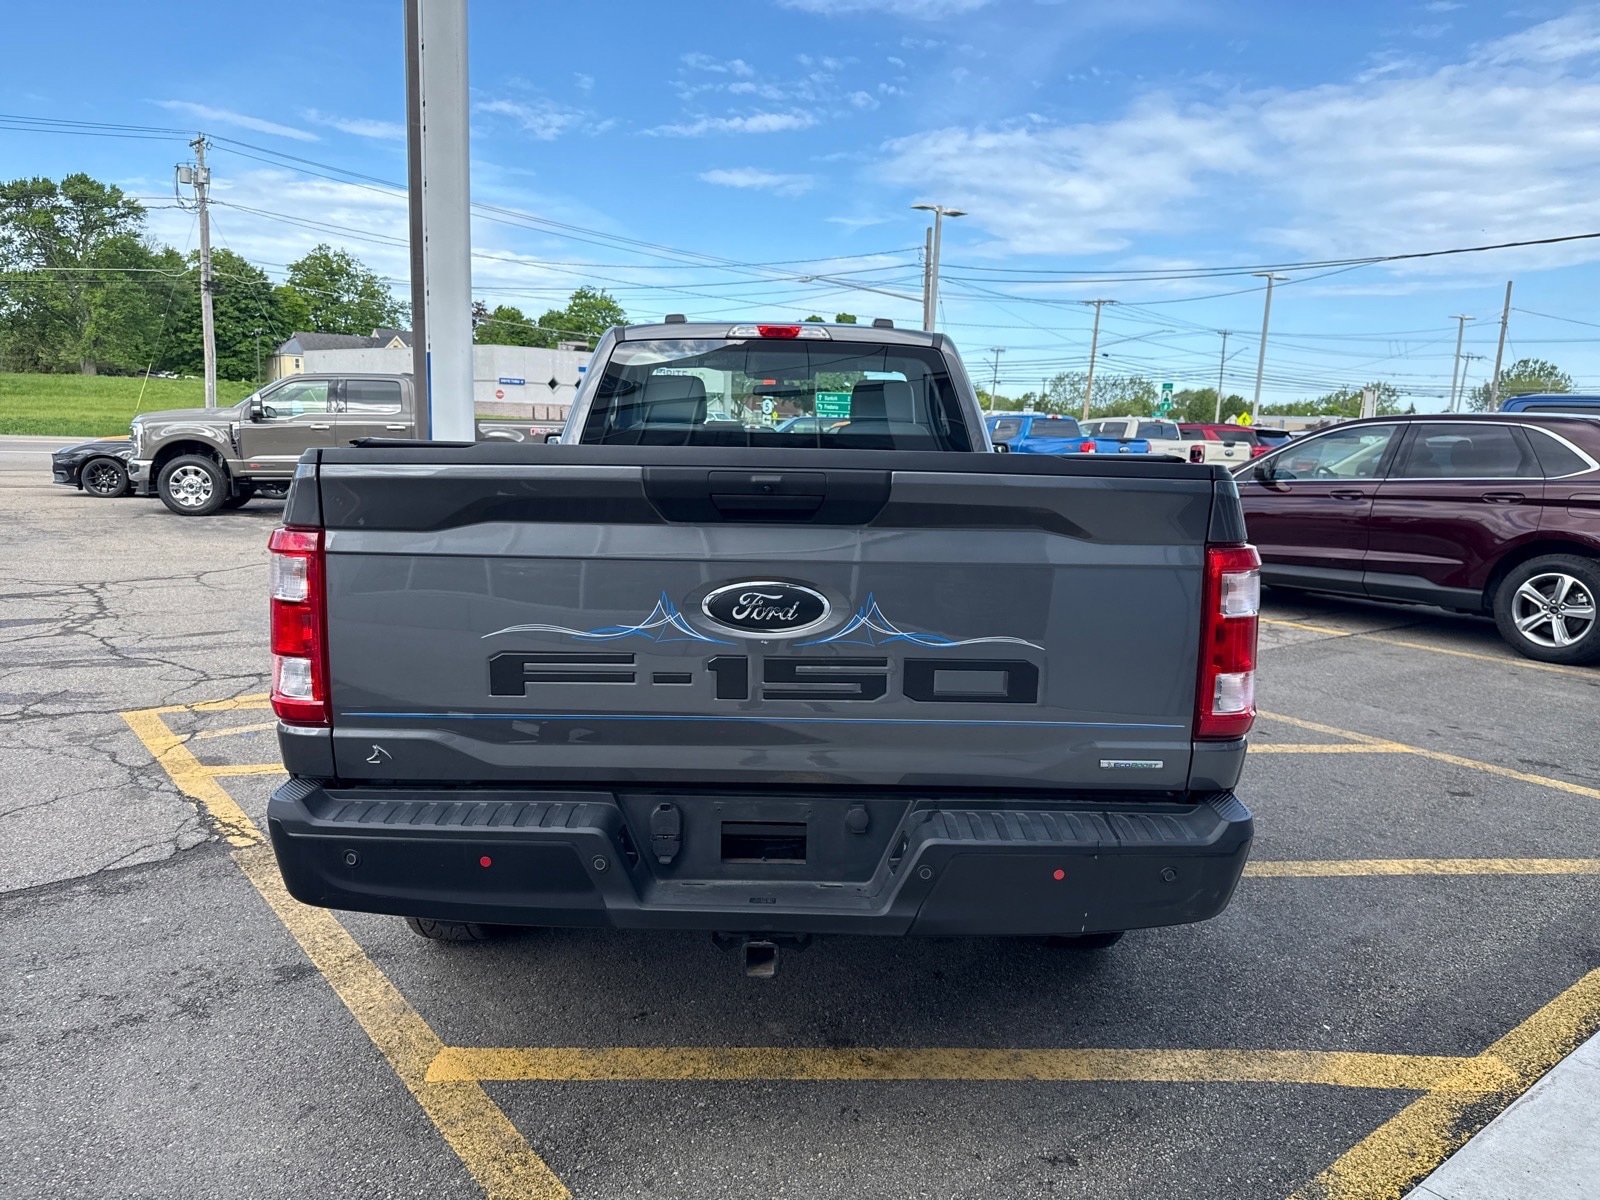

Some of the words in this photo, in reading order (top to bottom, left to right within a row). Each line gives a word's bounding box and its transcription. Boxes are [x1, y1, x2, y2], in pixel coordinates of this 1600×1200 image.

[764, 402, 770, 412] 5
[732, 592, 800, 620] Ford
[489, 650, 1039, 704] F-150
